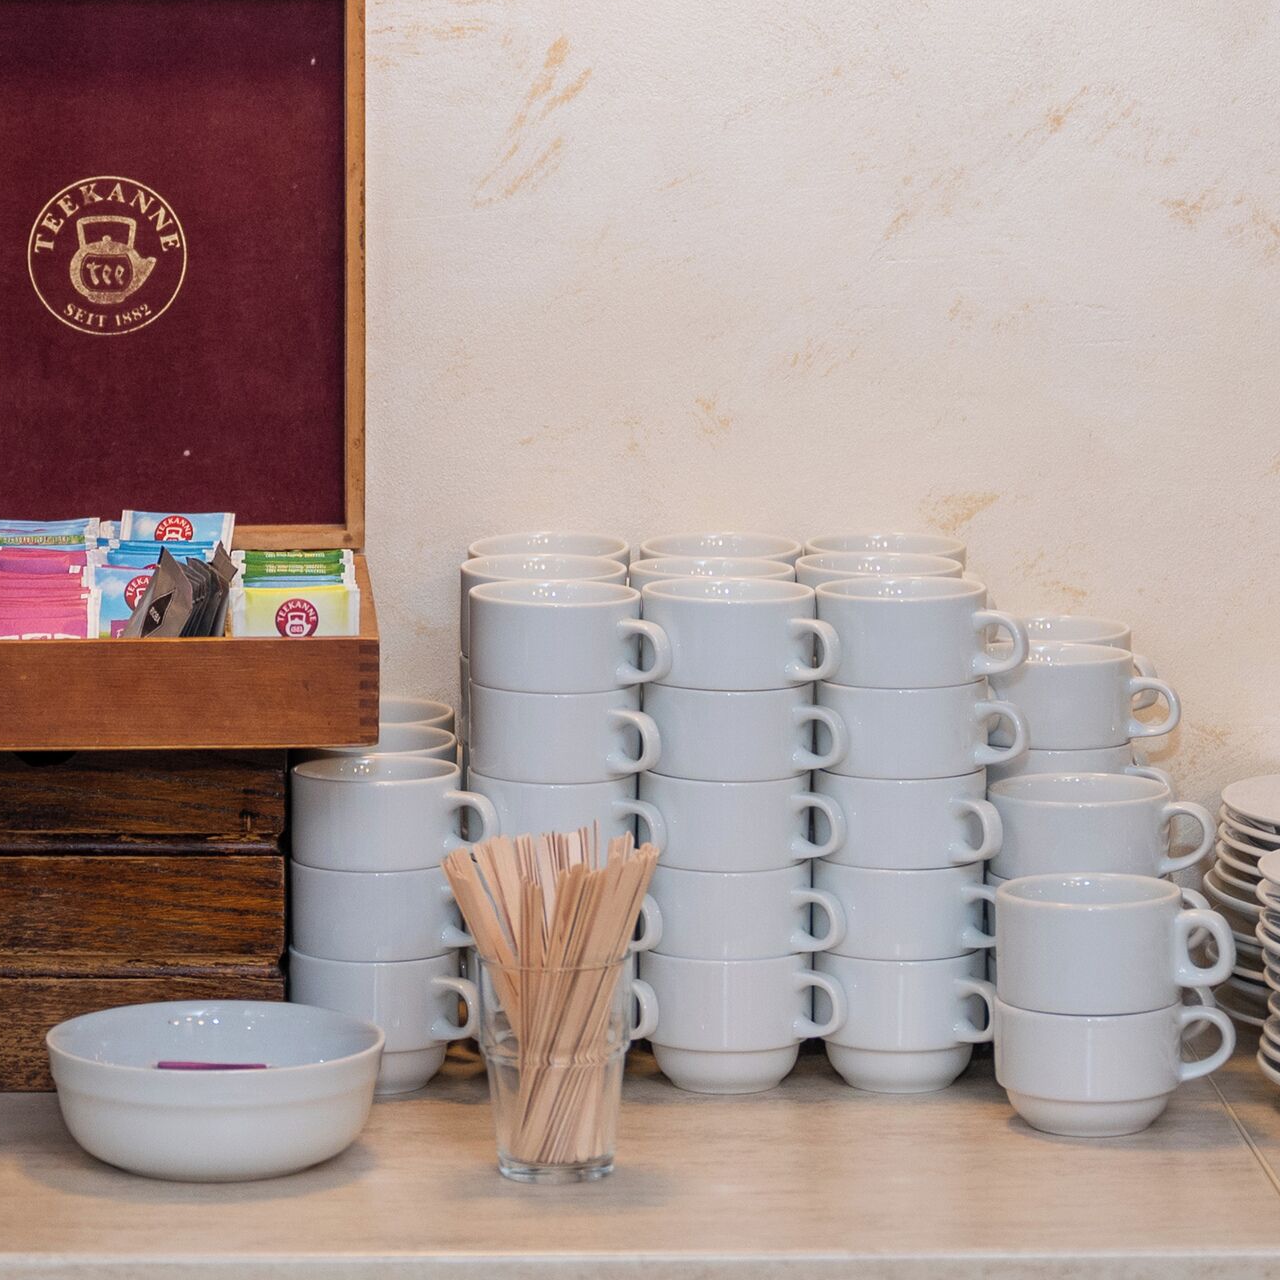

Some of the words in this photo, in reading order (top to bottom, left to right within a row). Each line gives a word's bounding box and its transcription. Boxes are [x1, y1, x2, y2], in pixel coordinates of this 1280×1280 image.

[34, 182, 181, 254] TEEKANNE
[85, 261, 125, 287] tee
[63, 303, 107, 328] SEIT
[114, 302, 153, 327] 1882
[156, 517, 193, 537] TEEKANNE
[125, 577, 150, 597] TEEKA
[276, 601, 318, 623] TEEKANNE
